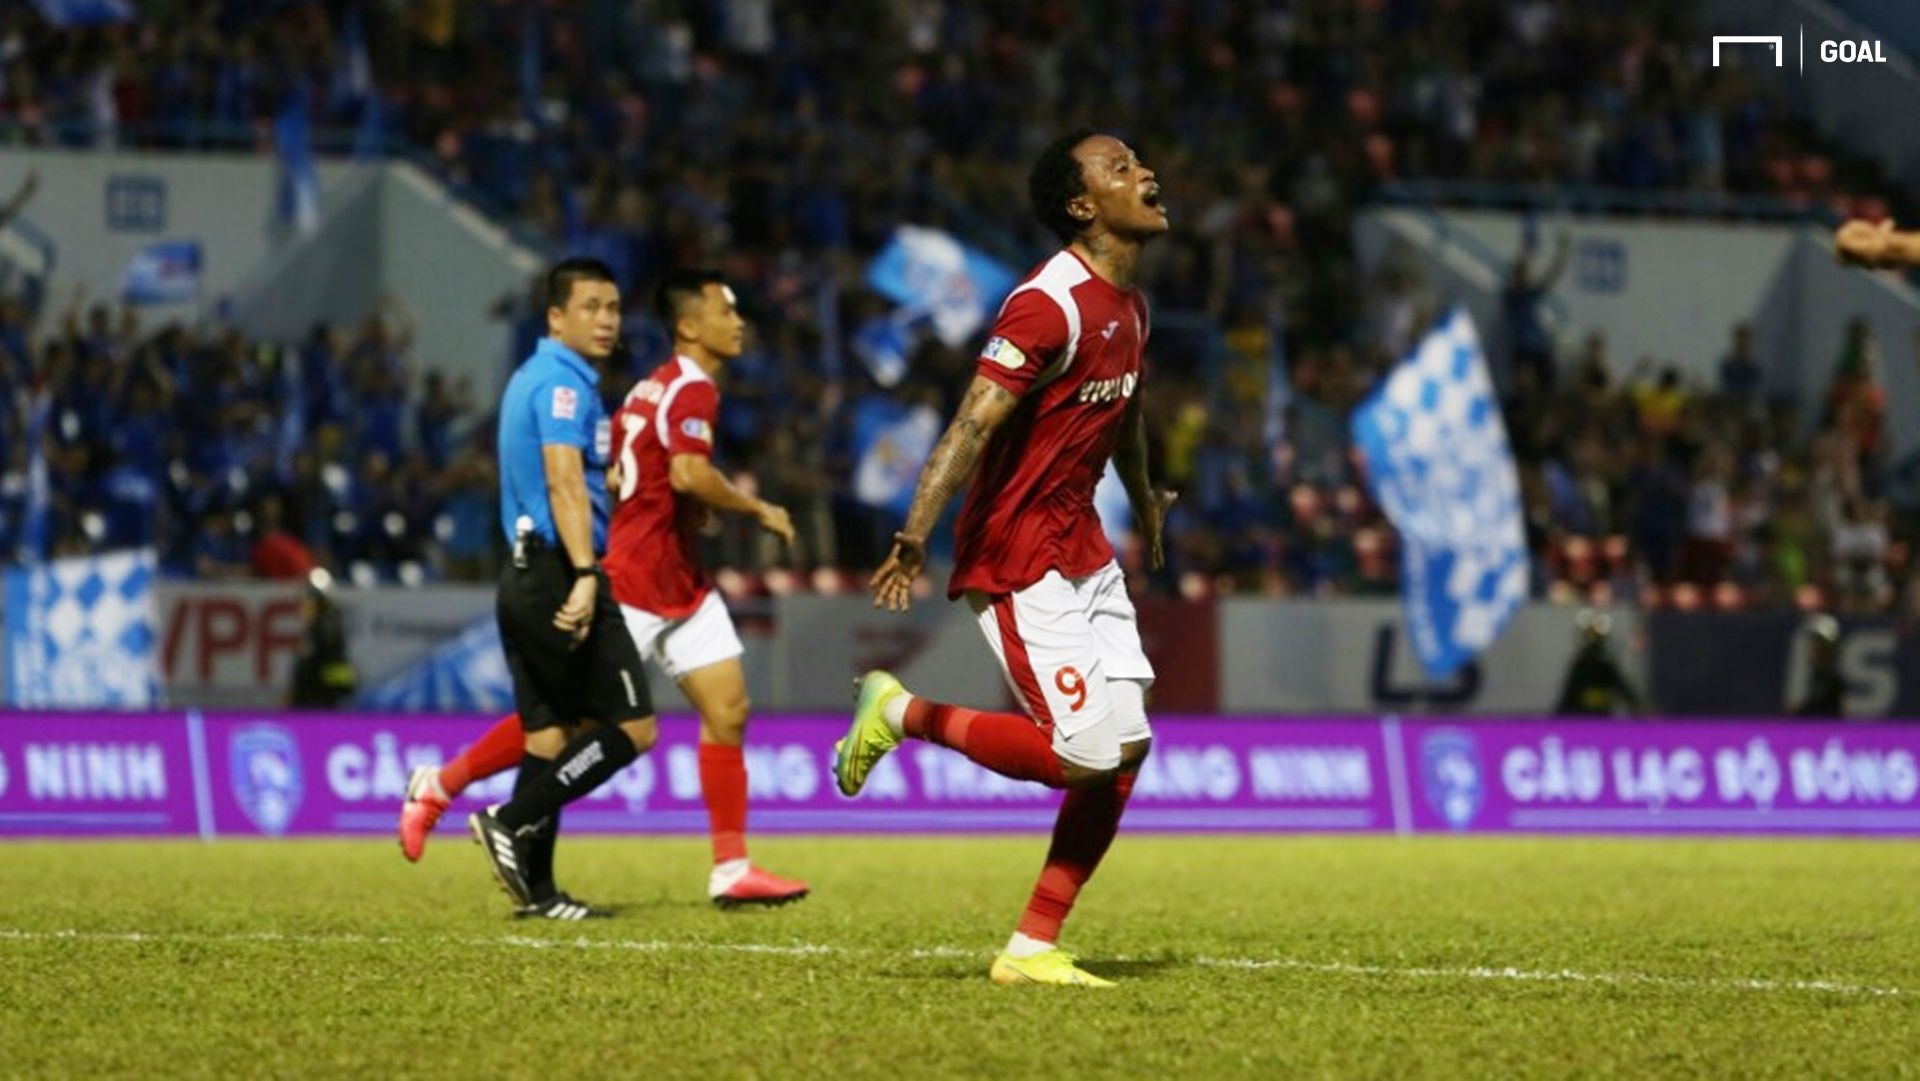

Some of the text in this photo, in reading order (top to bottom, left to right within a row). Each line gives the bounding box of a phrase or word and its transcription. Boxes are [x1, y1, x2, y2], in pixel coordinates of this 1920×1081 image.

[1054, 666, 1087, 713] 9
[26, 743, 166, 800] NINH
[1250, 746, 1373, 800] NINH
[1502, 735, 1918, 815] CÂU LẠC BỘ BÓNG
